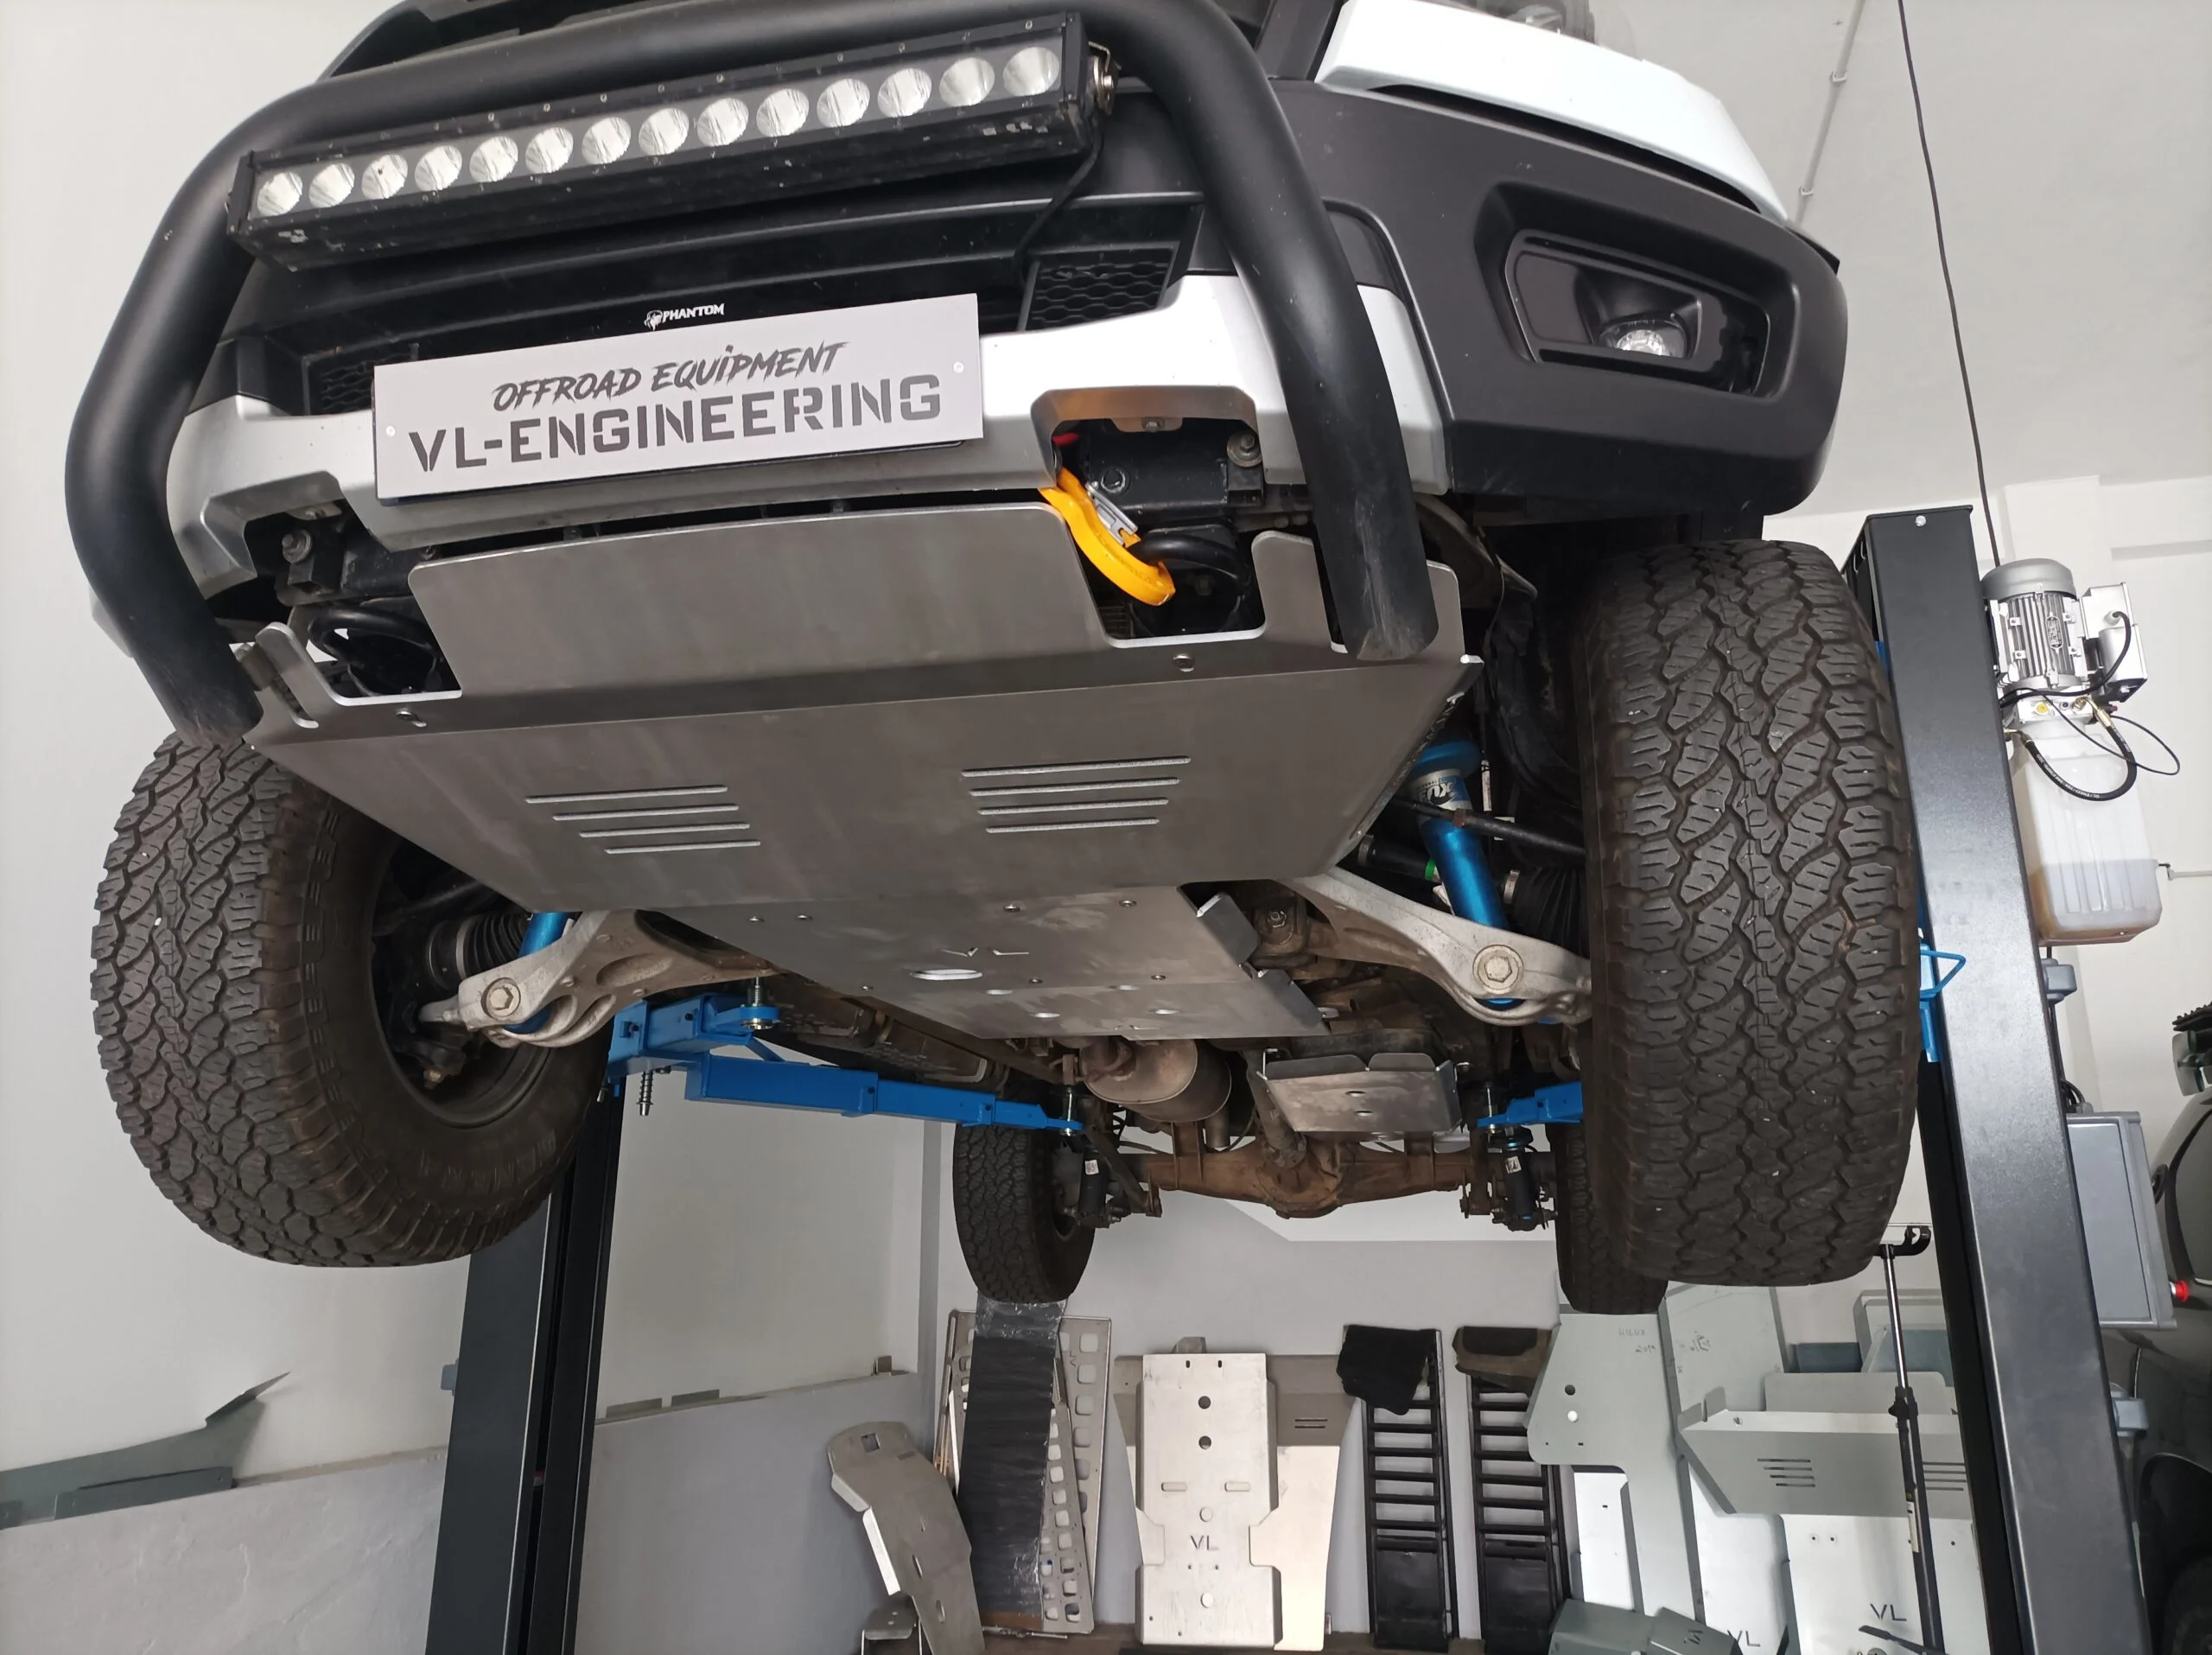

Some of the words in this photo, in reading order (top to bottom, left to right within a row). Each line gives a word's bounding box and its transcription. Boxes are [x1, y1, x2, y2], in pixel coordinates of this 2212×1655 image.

[662, 302, 725, 323] PHANTOM
[492, 367, 641, 413] OFFROAD
[408, 373, 943, 474] VL-ENGINEERING
[1190, 1534, 1219, 1551] VL
[1869, 1603, 1908, 1622] VL
[1726, 1629, 1761, 1647] VL
